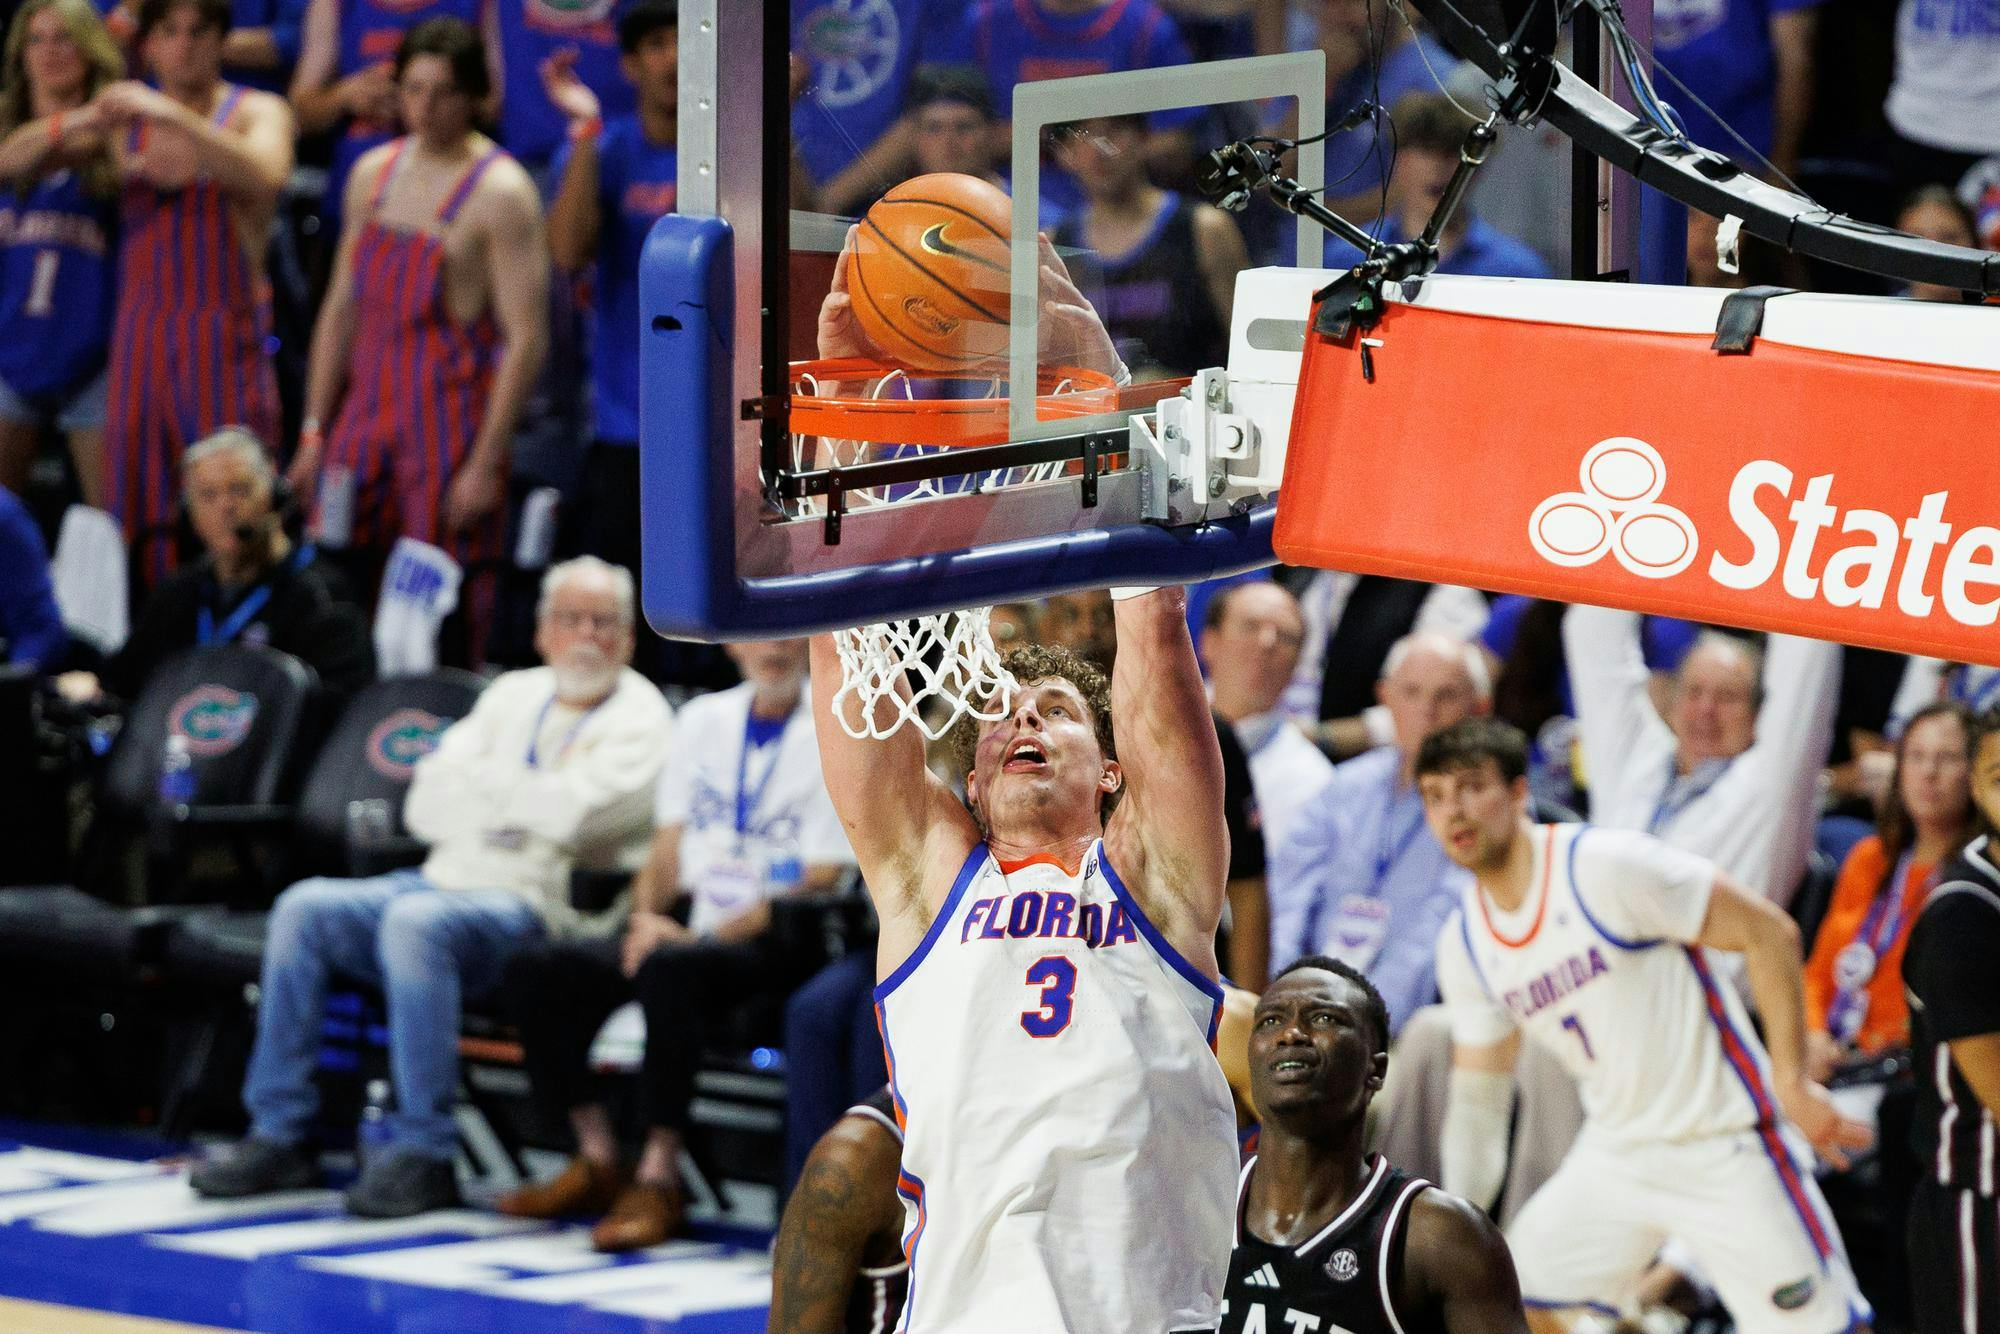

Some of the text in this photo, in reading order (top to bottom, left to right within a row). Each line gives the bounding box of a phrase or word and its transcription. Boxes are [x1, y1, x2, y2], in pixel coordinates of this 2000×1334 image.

[1708, 459, 2000, 627] State
[1020, 956, 1078, 1039] 3
[1332, 1250, 1356, 1272] SEC
